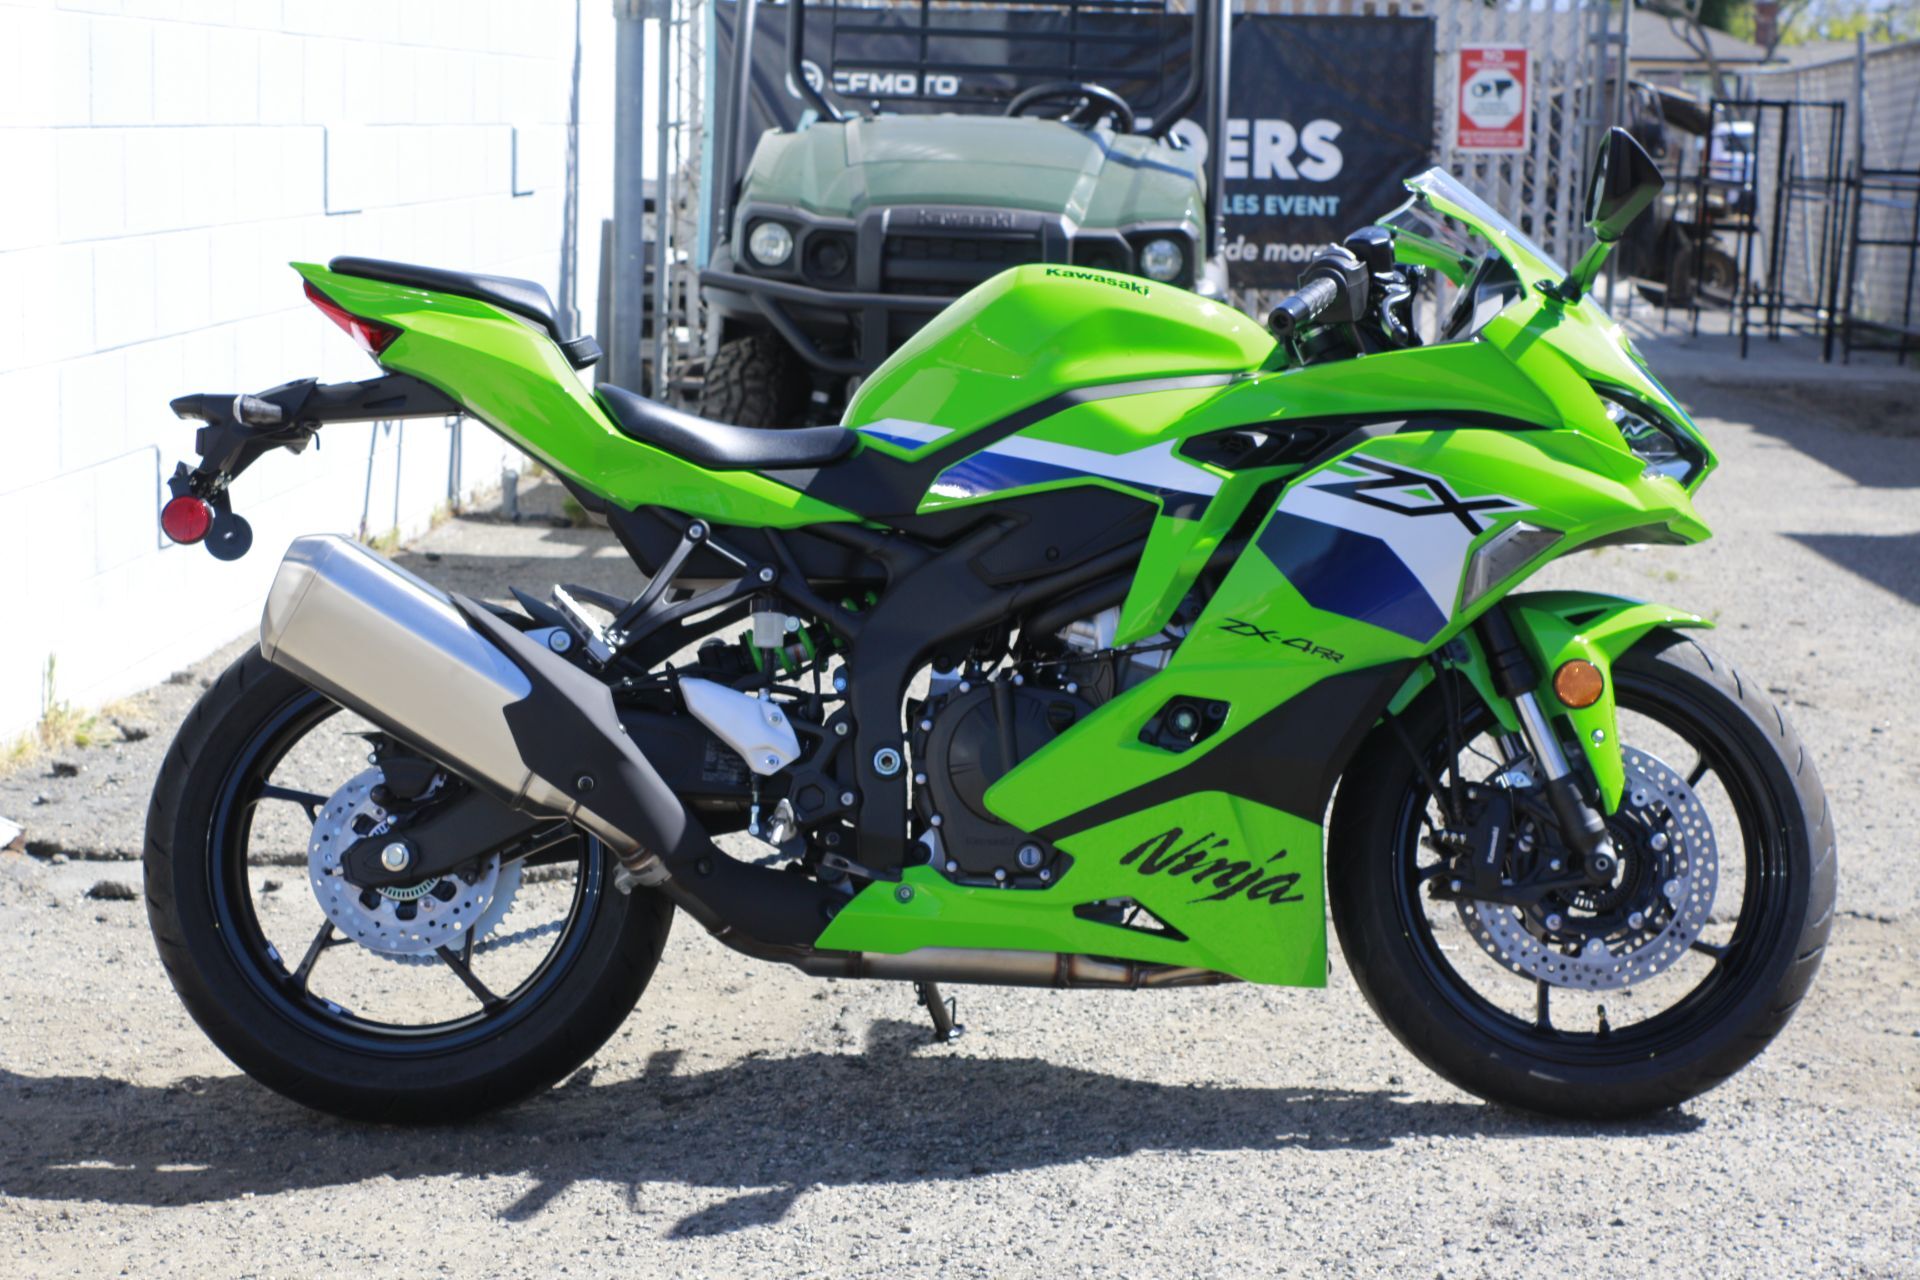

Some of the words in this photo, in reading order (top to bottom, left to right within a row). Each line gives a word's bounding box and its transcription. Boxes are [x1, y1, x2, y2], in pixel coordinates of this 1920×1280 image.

[1222, 194, 1259, 214] LES
[1264, 195, 1340, 216] EVENT
[1225, 234, 1259, 261] de
[1045, 268, 1150, 296] Kawasaki
[1305, 454, 1521, 536] ZX
[1119, 827, 1304, 905] Ninja
